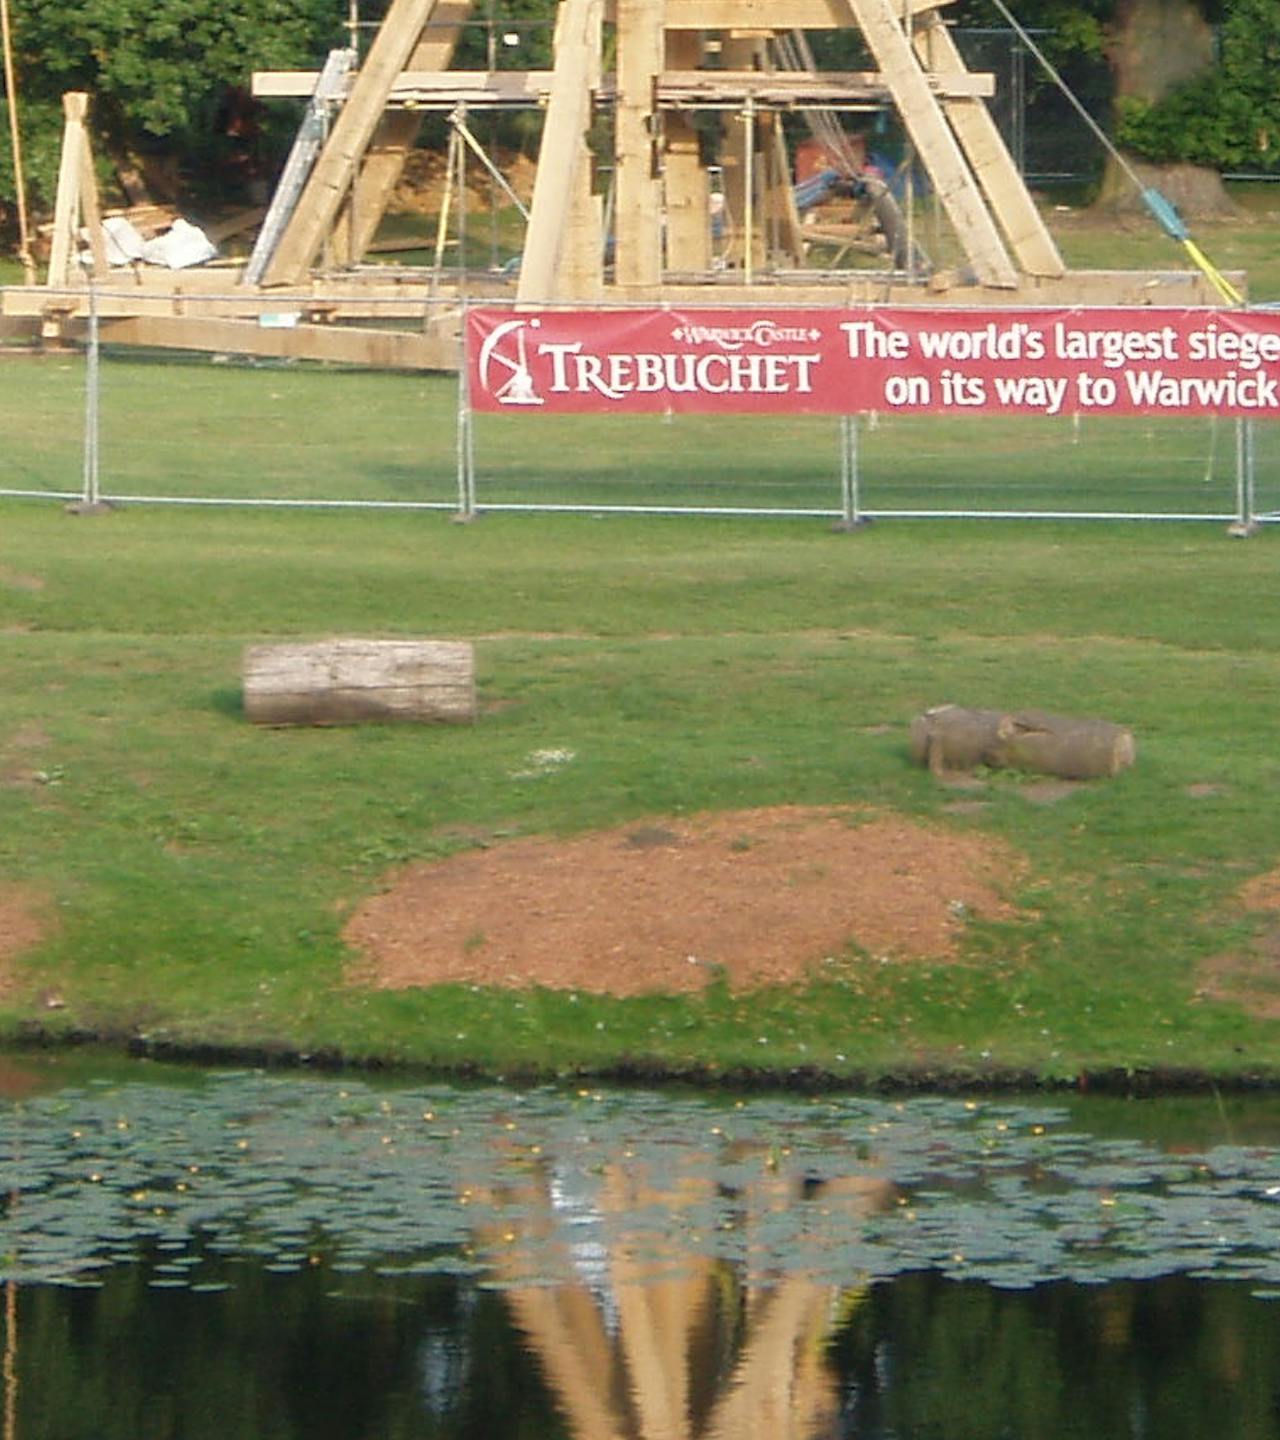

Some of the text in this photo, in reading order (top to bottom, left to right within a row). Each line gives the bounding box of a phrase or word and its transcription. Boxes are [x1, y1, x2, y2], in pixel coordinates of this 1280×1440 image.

[840, 322, 910, 359] The
[920, 322, 1045, 360] world's
[1056, 323, 1178, 368] largest
[538, 341, 821, 399] TREBUCHET
[885, 376, 930, 405] on
[940, 370, 986, 405] its
[994, 377, 1068, 414] way
[1078, 373, 1116, 406] to
[1124, 370, 1280, 407] Warwick
